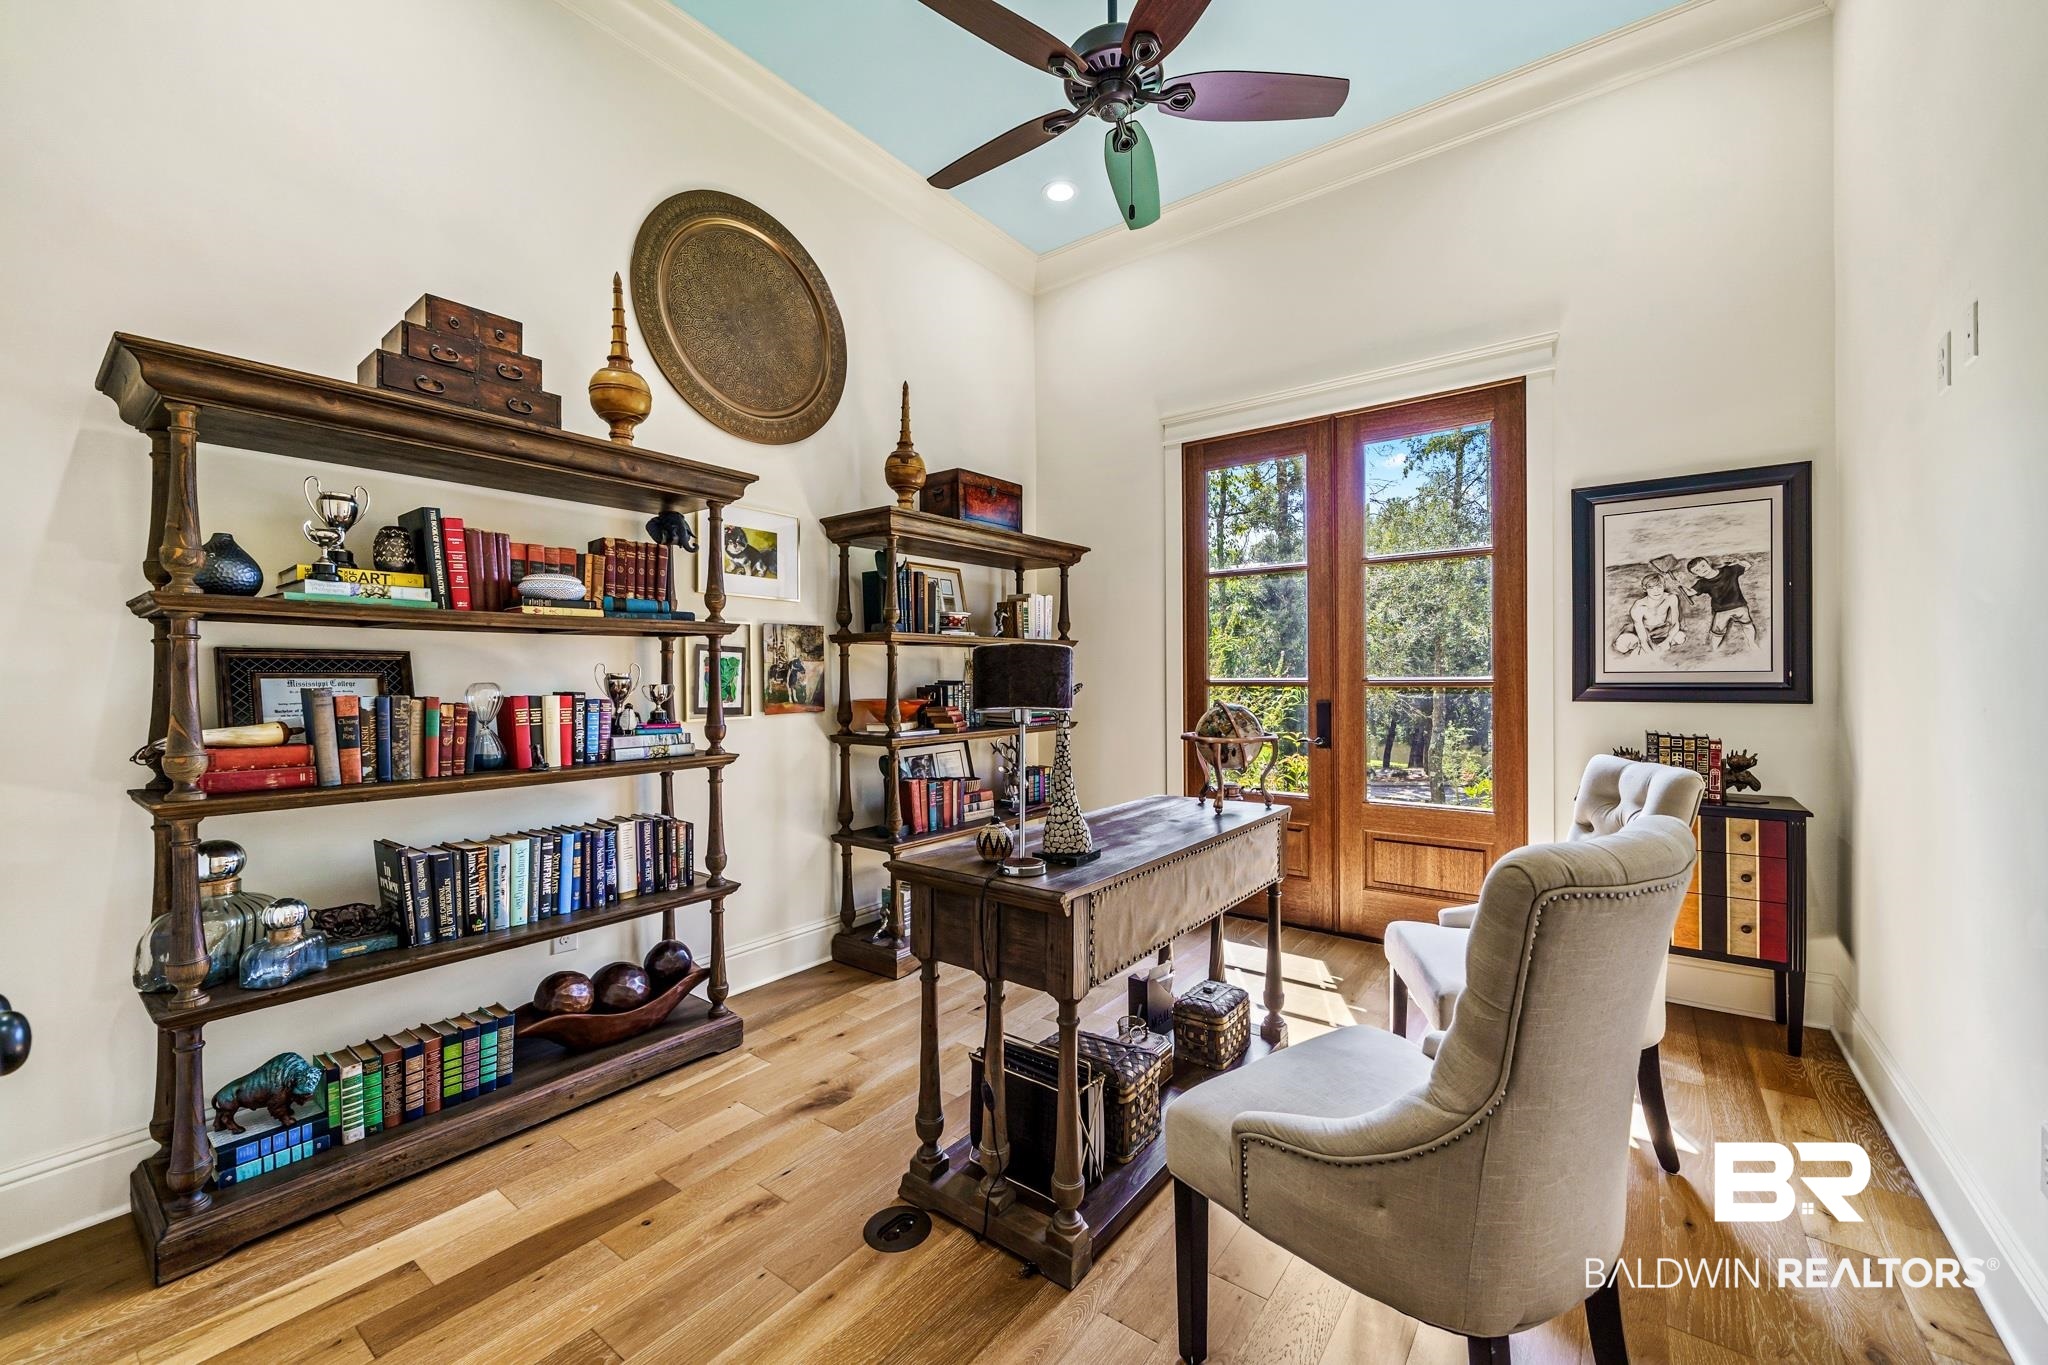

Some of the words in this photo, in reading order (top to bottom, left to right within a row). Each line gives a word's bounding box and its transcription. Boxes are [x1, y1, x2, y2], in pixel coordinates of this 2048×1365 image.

[430, 520, 438, 536] BOOK
[433, 543, 441, 559] INSIDE
[349, 570, 358, 582] OF
[359, 572, 390, 585] ART
[435, 560, 445, 595] INFORMATION
[330, 679, 355, 687] College
[576, 702, 584, 711] The
[575, 711, 584, 730] Tangent
[575, 730, 584, 752] Objective
[466, 850, 478, 873] James
[478, 850, 487, 863] The
[468, 873, 477, 882] A.
[478, 863, 487, 896] Covenant
[493, 864, 501, 879] Sum
[542, 854, 552, 895] AIRFRAME
[444, 878, 452, 904] KREMLIN
[468, 882, 478, 915] Michener
[492, 900, 502, 919] Fears
